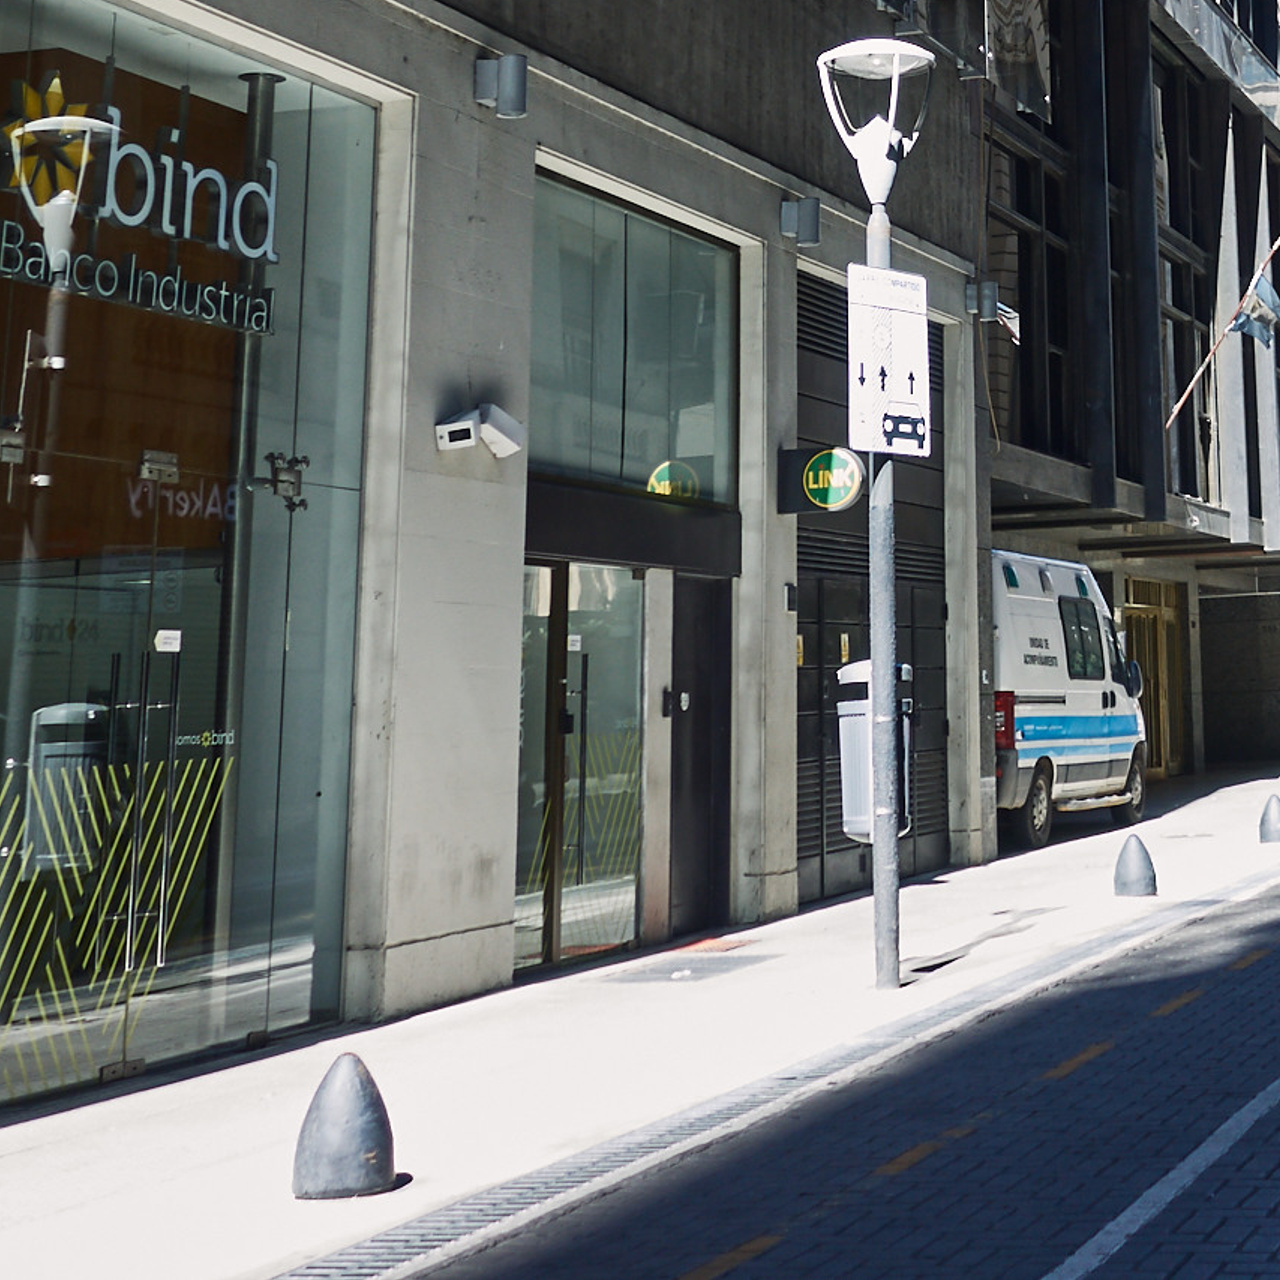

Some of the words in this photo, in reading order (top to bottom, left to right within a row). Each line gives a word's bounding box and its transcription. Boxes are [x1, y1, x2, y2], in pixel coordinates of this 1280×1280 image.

[99, 106, 278, 262] bind
[1, 221, 119, 296] Banco
[128, 253, 275, 333] Industrial
[808, 463, 854, 489] LINK
[175, 735, 200, 746] omos
